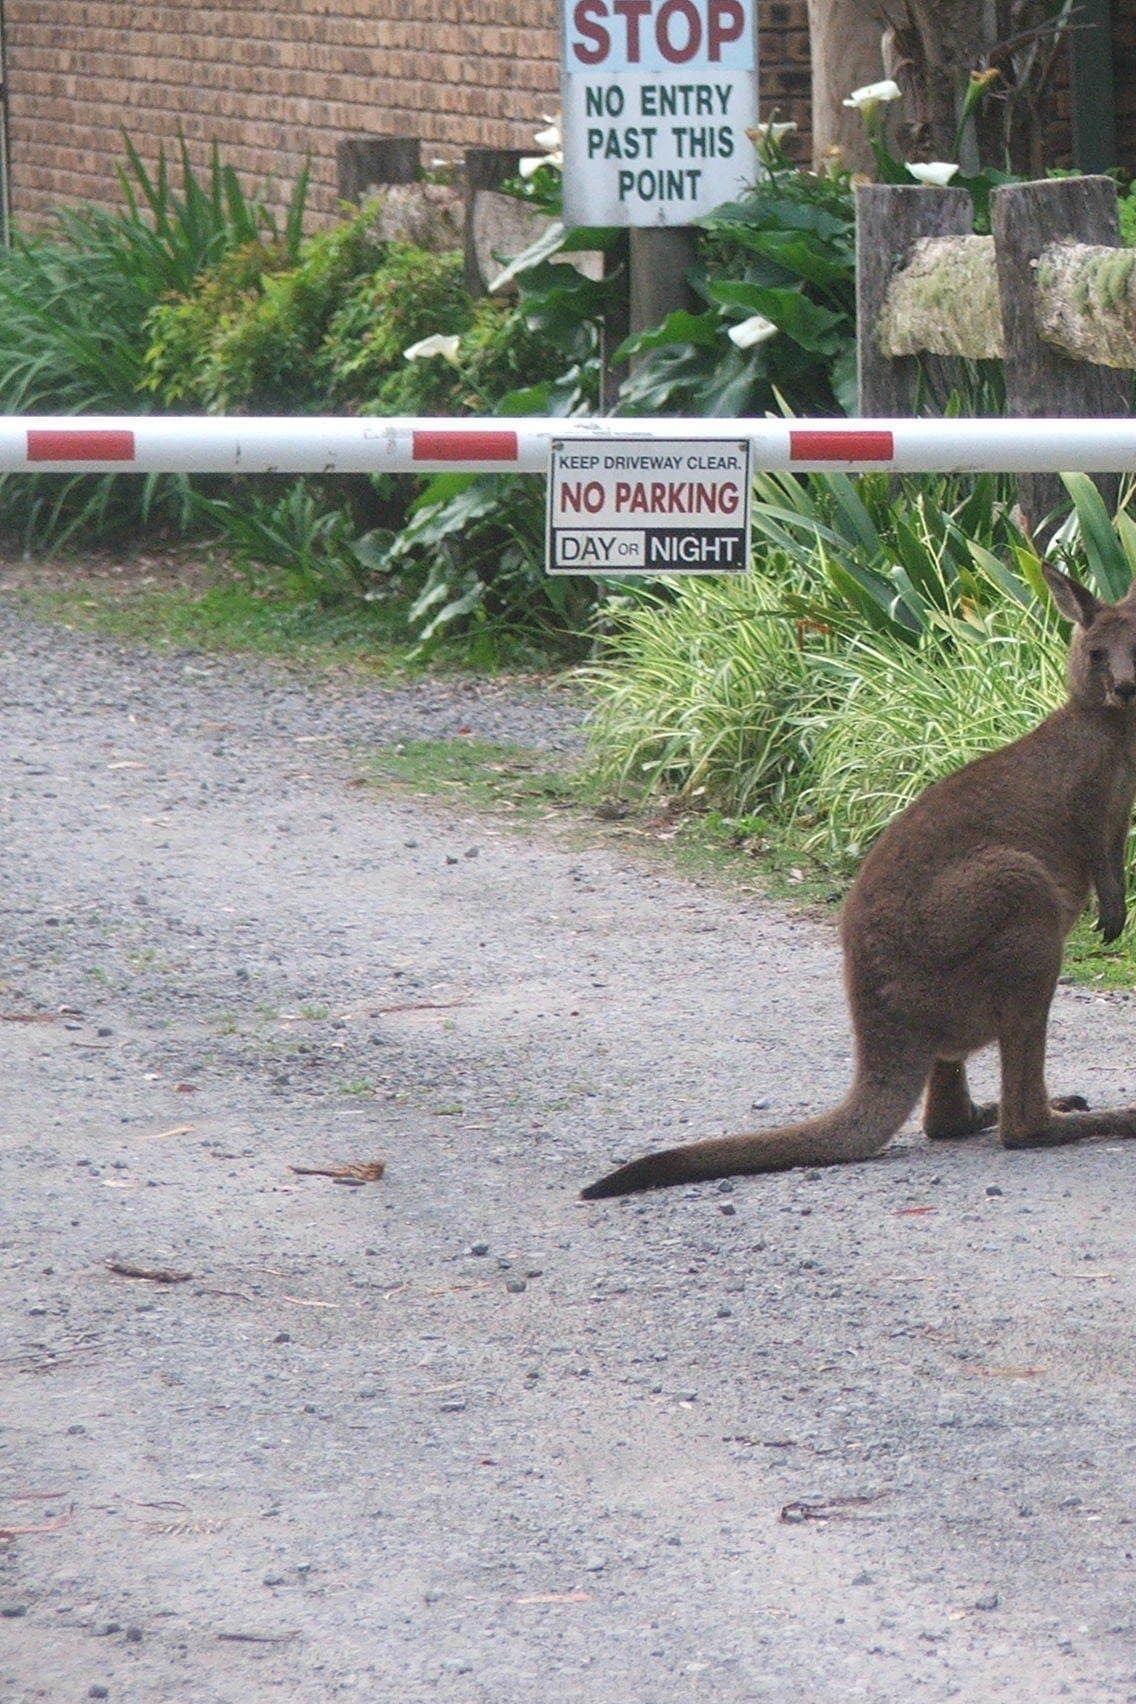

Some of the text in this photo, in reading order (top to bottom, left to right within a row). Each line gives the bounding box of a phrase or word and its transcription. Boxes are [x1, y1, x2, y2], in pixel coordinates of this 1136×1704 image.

[573, 0, 745, 64] STOP
[585, 84, 733, 117] NO ENTRY
[587, 126, 734, 159] PAST THIS
[618, 169, 702, 200] POINT
[559, 456, 742, 470] KEEP DRIVEWAY CLEAR.
[560, 481, 739, 514] NO PARKING
[561, 536, 739, 562] DAY OR NIGHT
